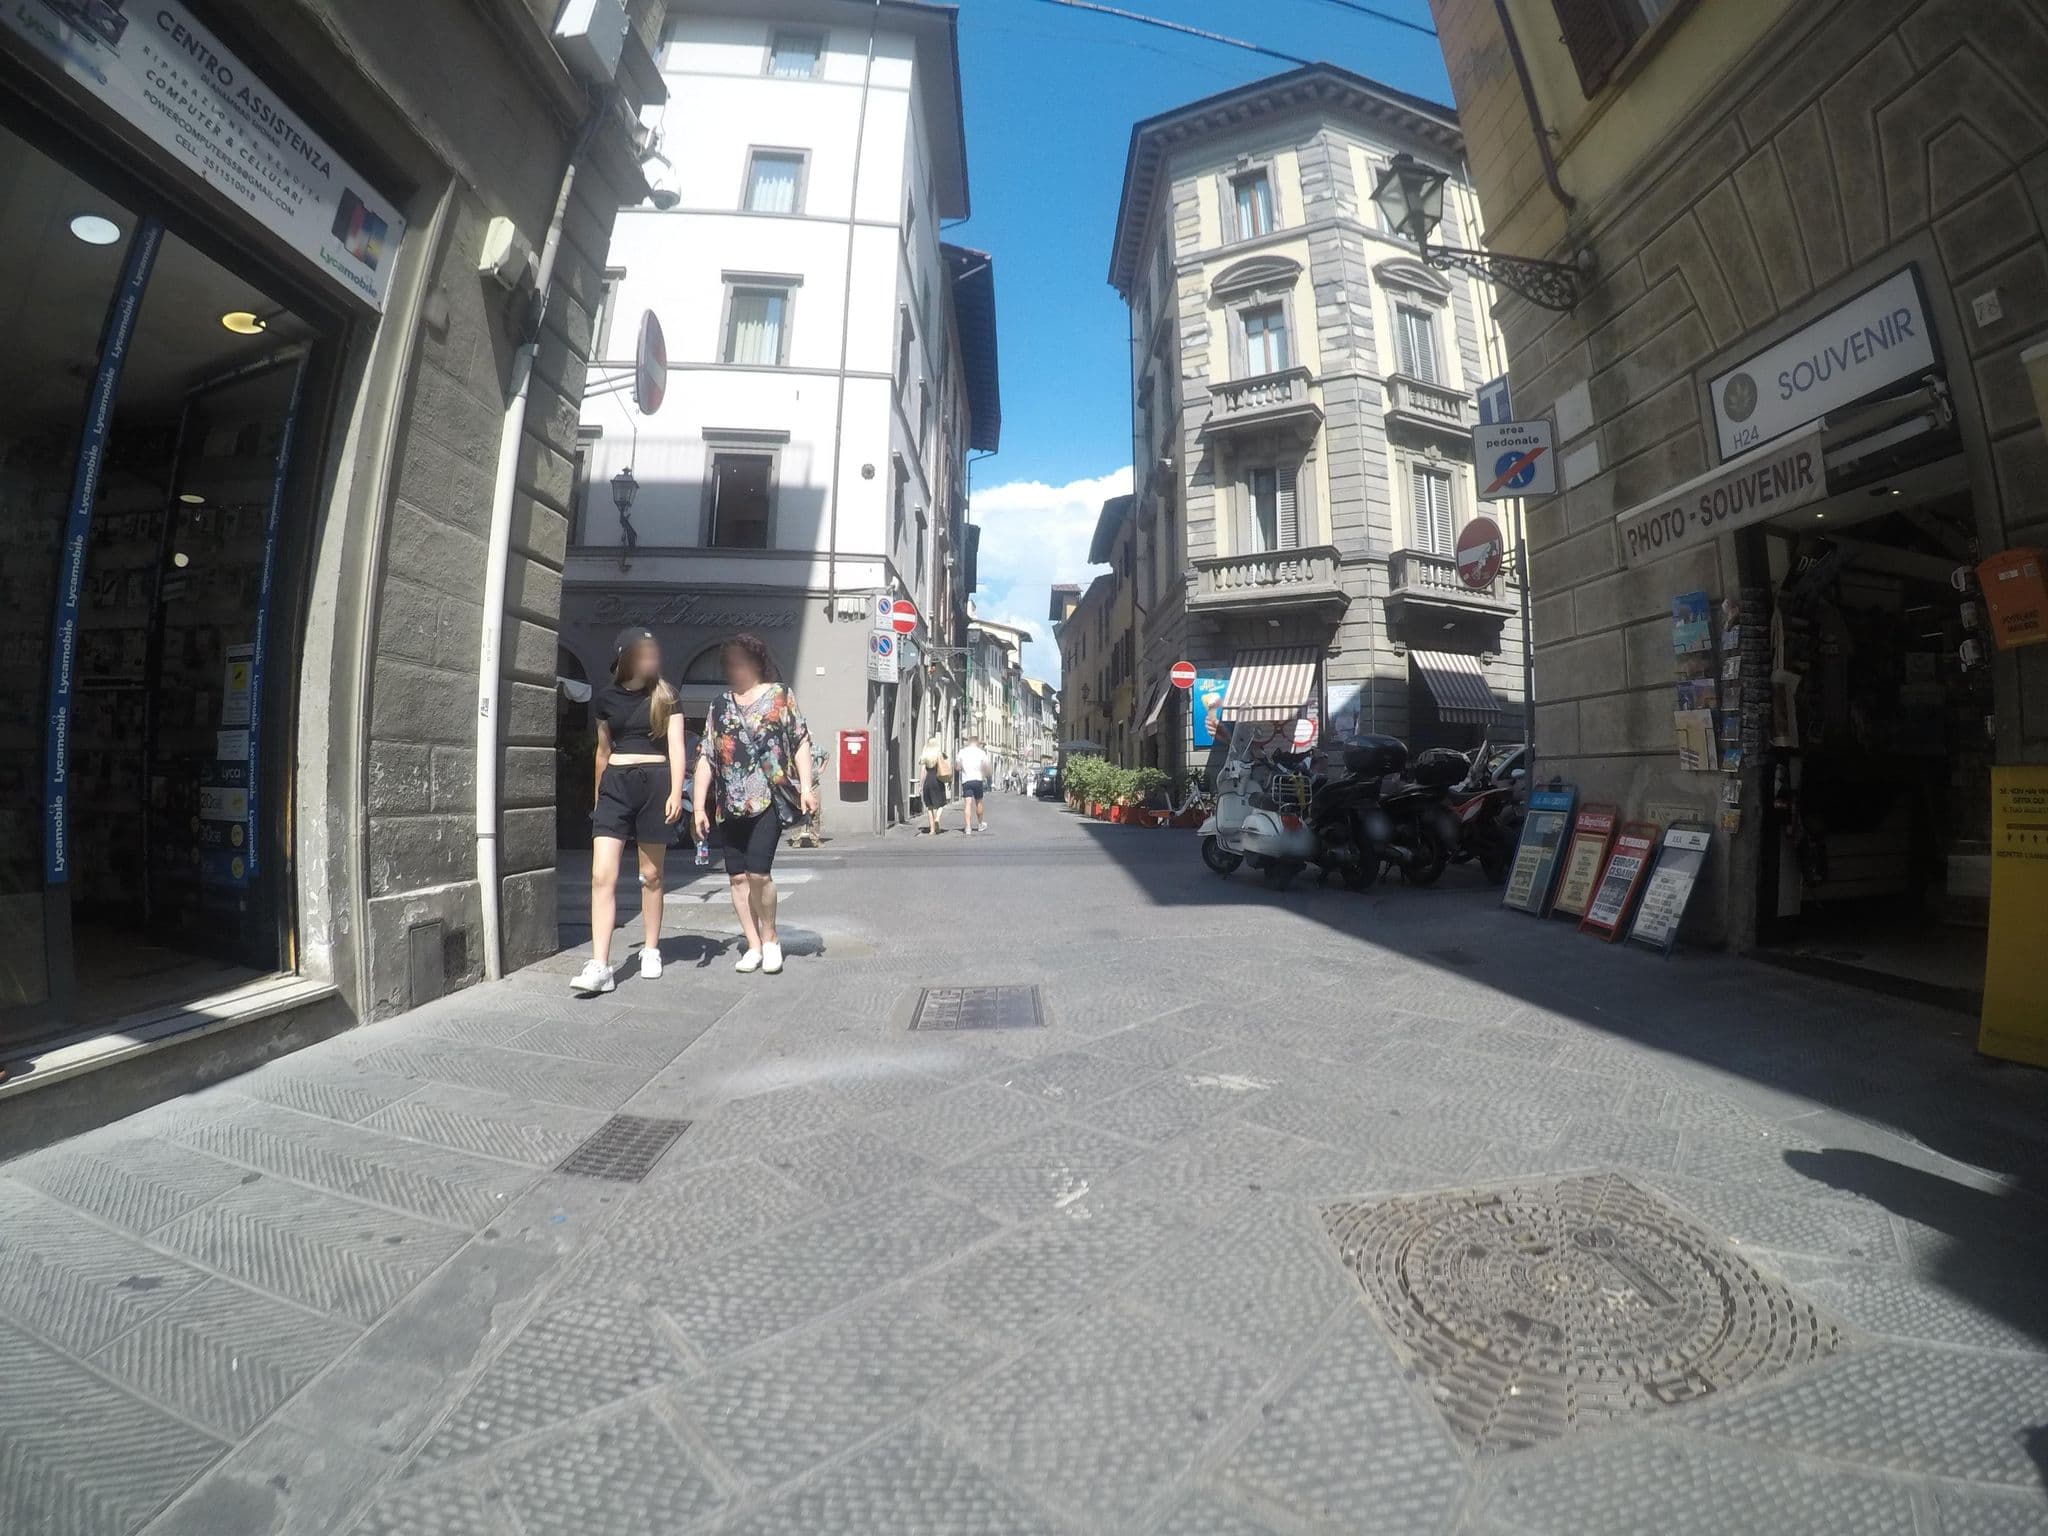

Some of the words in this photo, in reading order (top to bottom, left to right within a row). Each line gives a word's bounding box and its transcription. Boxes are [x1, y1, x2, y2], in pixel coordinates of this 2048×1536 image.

[143, 46, 245, 137] RIPARAZIONE
[267, 152, 320, 203] VENDITA
[156, 10, 233, 86] CENTRO
[237, 86, 331, 180] ASSISTENZA
[146, 70, 222, 136] COMPUTER
[226, 137, 234, 149] &
[239, 149, 303, 205] CELLULARI
[319, 245, 378, 298] Lycamobile
[111, 296, 136, 360] Lycamobile
[1778, 307, 1915, 400] SOUVENIR
[93, 367, 116, 435] Lycamobile
[1500, 426, 1525, 435] area
[1733, 425, 1760, 449] H24
[1486, 436, 1540, 449] pedonale
[79, 445, 99, 515] Lycamobile
[1627, 508, 1685, 557] PHOTO
[1700, 452, 1814, 526] SOUVENIR
[66, 535, 84, 608] Lycamobile
[58, 619, 74, 694] Lycamobile
[55, 706, 67, 783] Lycamobile
[54, 795, 64, 872] Lycamobile
